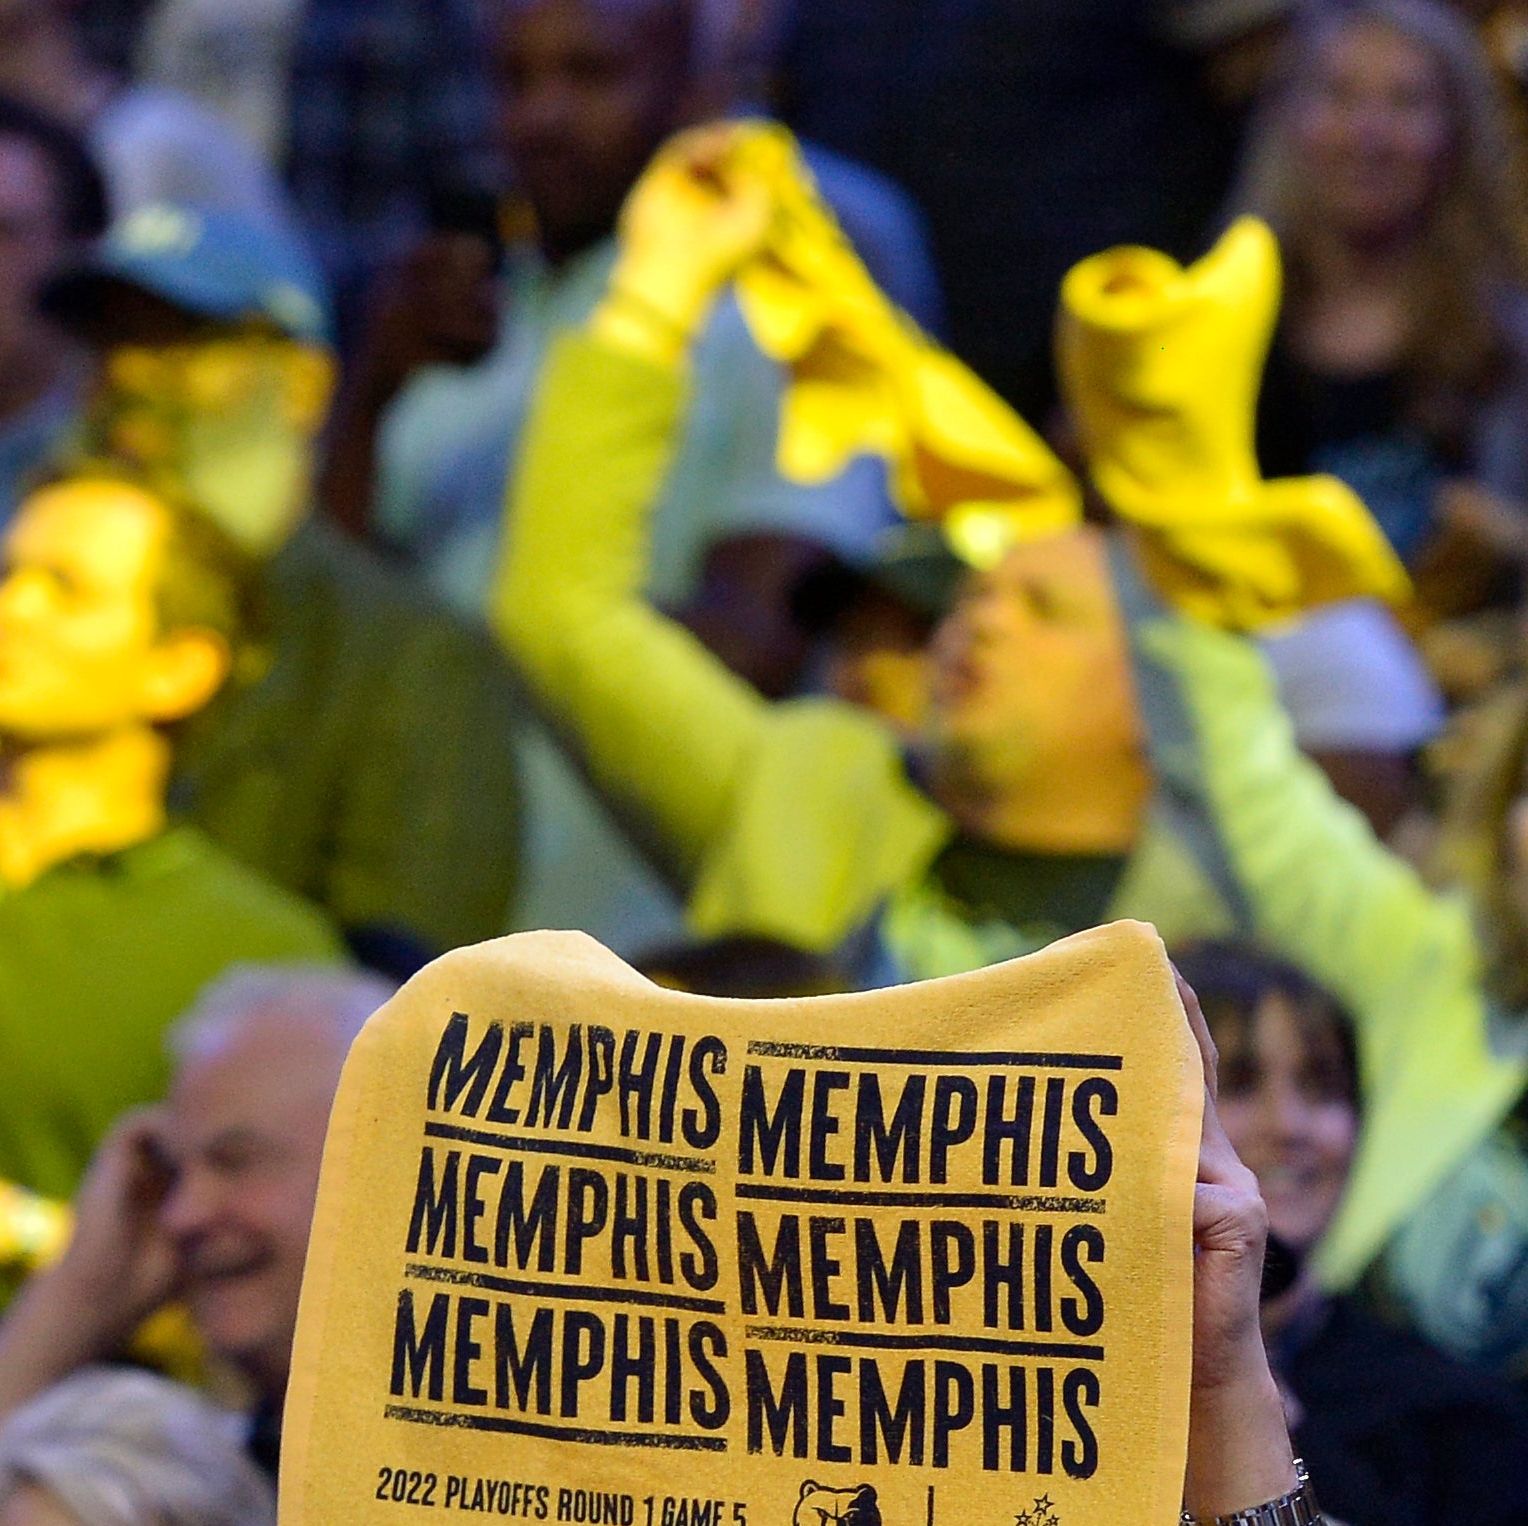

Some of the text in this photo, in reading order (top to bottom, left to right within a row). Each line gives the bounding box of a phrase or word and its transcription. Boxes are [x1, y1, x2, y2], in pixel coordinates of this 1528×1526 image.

[427, 1011, 728, 1150] MEMPHIS
[738, 1064, 1119, 1192] MEMPHIS
[405, 1146, 719, 1291] MEMPHIS
[736, 1210, 1106, 1337] MEMPHIS
[389, 1288, 731, 1430] MEMPHIS
[744, 1348, 1101, 1480] MEMPHIS
[375, 1467, 438, 1507] 2022
[444, 1475, 549, 1520] PLAYOFFS
[557, 1488, 633, 1526] ROUND
